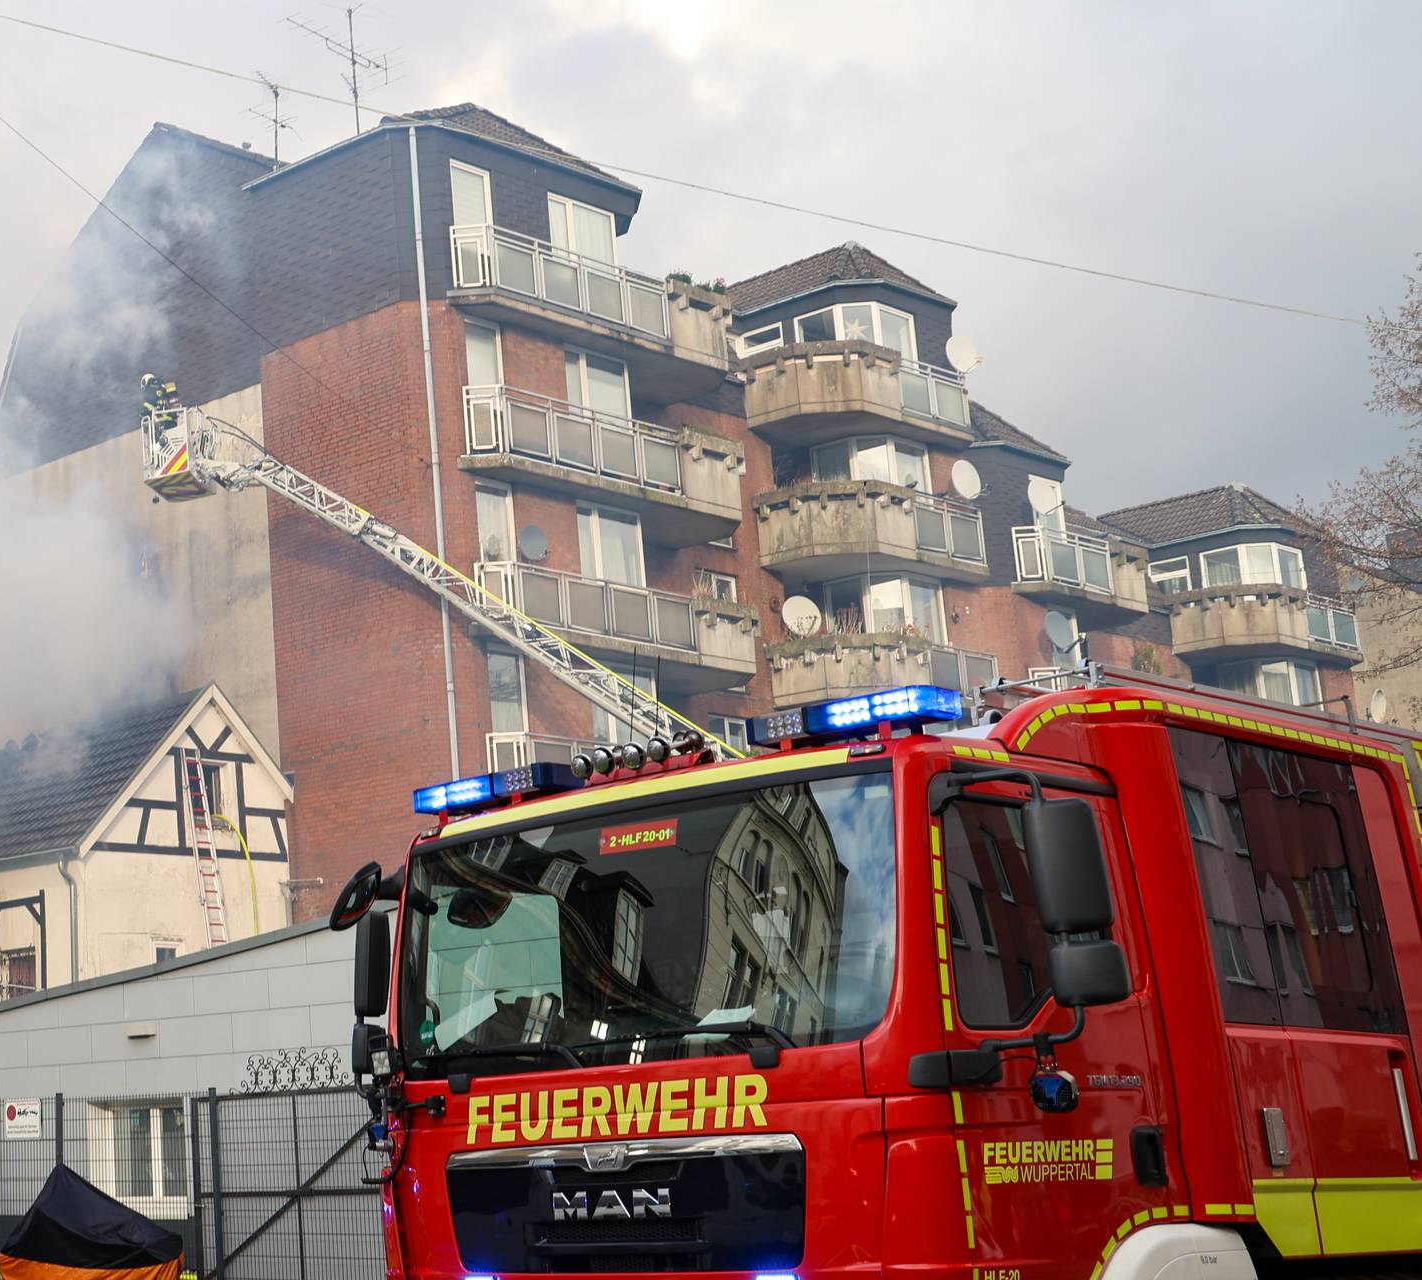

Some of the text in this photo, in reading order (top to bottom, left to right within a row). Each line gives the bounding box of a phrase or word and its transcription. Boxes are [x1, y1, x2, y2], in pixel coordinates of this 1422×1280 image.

[467, 1074, 767, 1144] FEUERWEHR
[983, 1140, 1095, 1165] FEUERWEHR
[1020, 1163, 1094, 1183] WUPPERTAL
[552, 1188, 672, 1221] MAN
